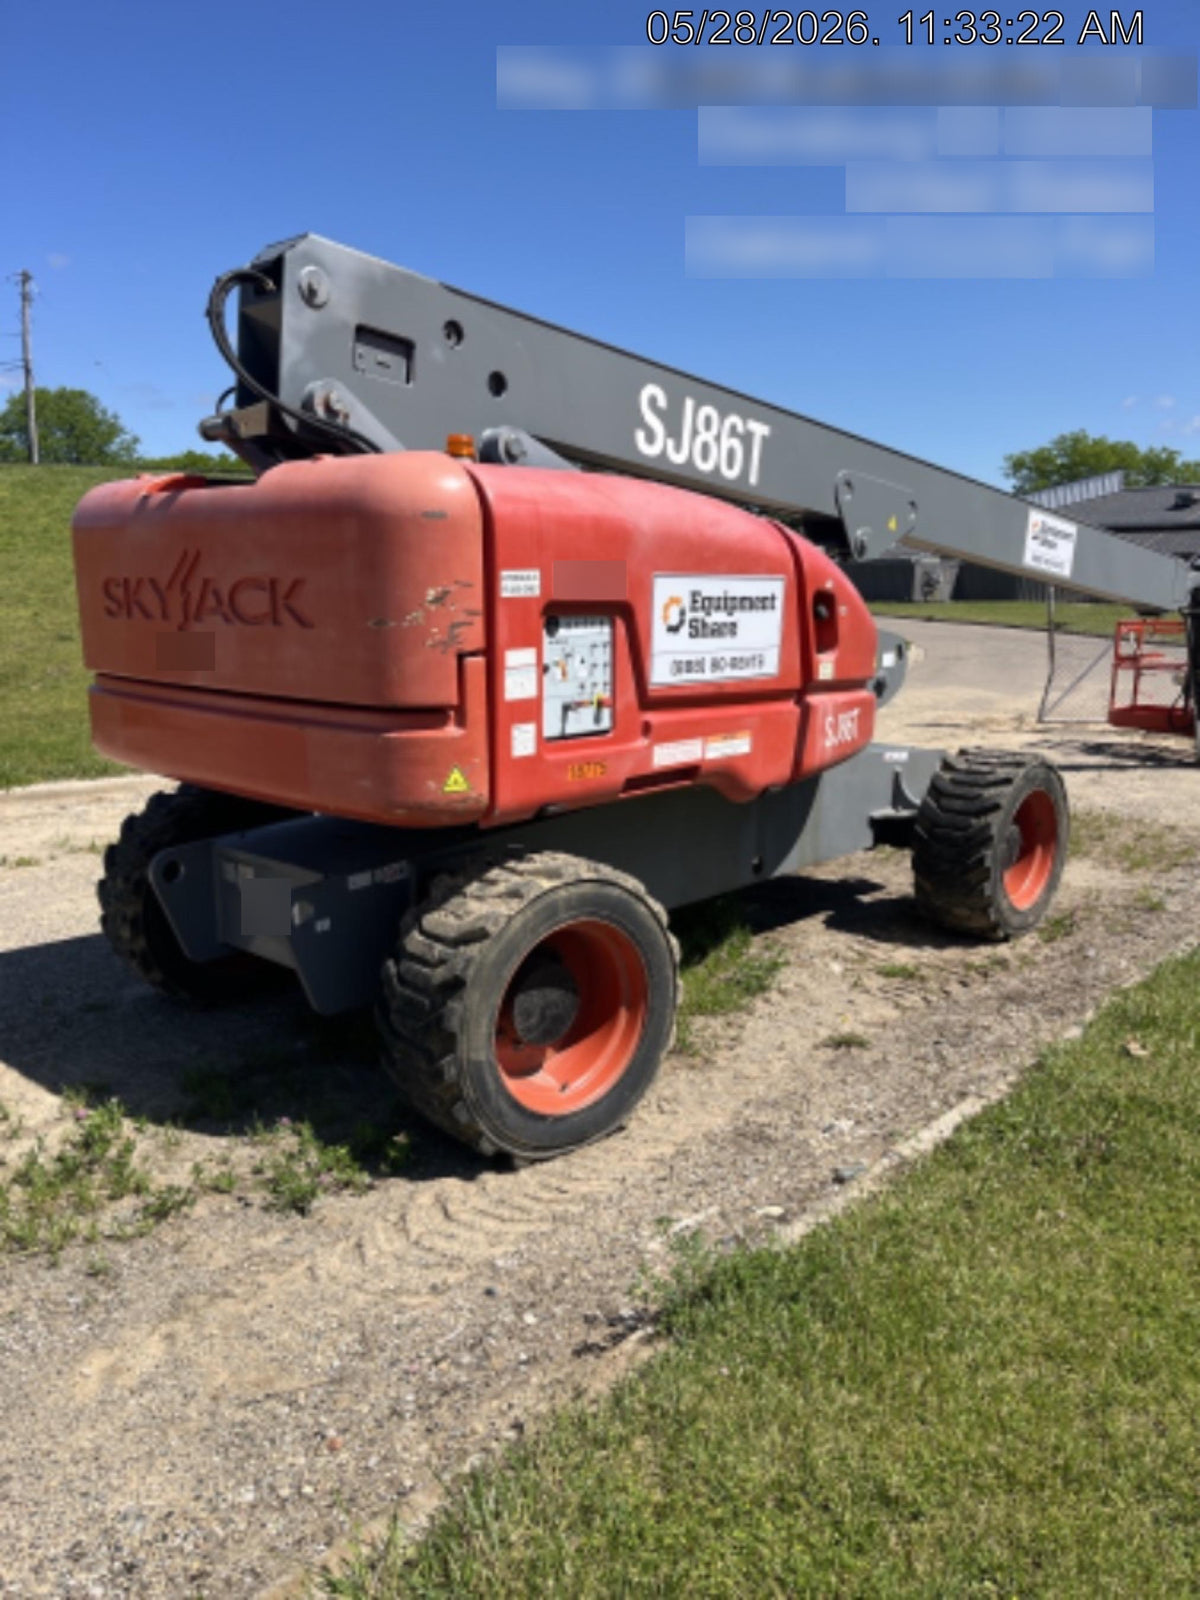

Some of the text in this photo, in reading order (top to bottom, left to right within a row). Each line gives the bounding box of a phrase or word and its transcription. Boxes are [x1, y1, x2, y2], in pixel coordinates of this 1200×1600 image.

[634, 383, 771, 486] SJ86T
[103, 549, 314, 632] SKYJACK
[689, 590, 776, 617] Equipment
[688, 618, 738, 639] Share
